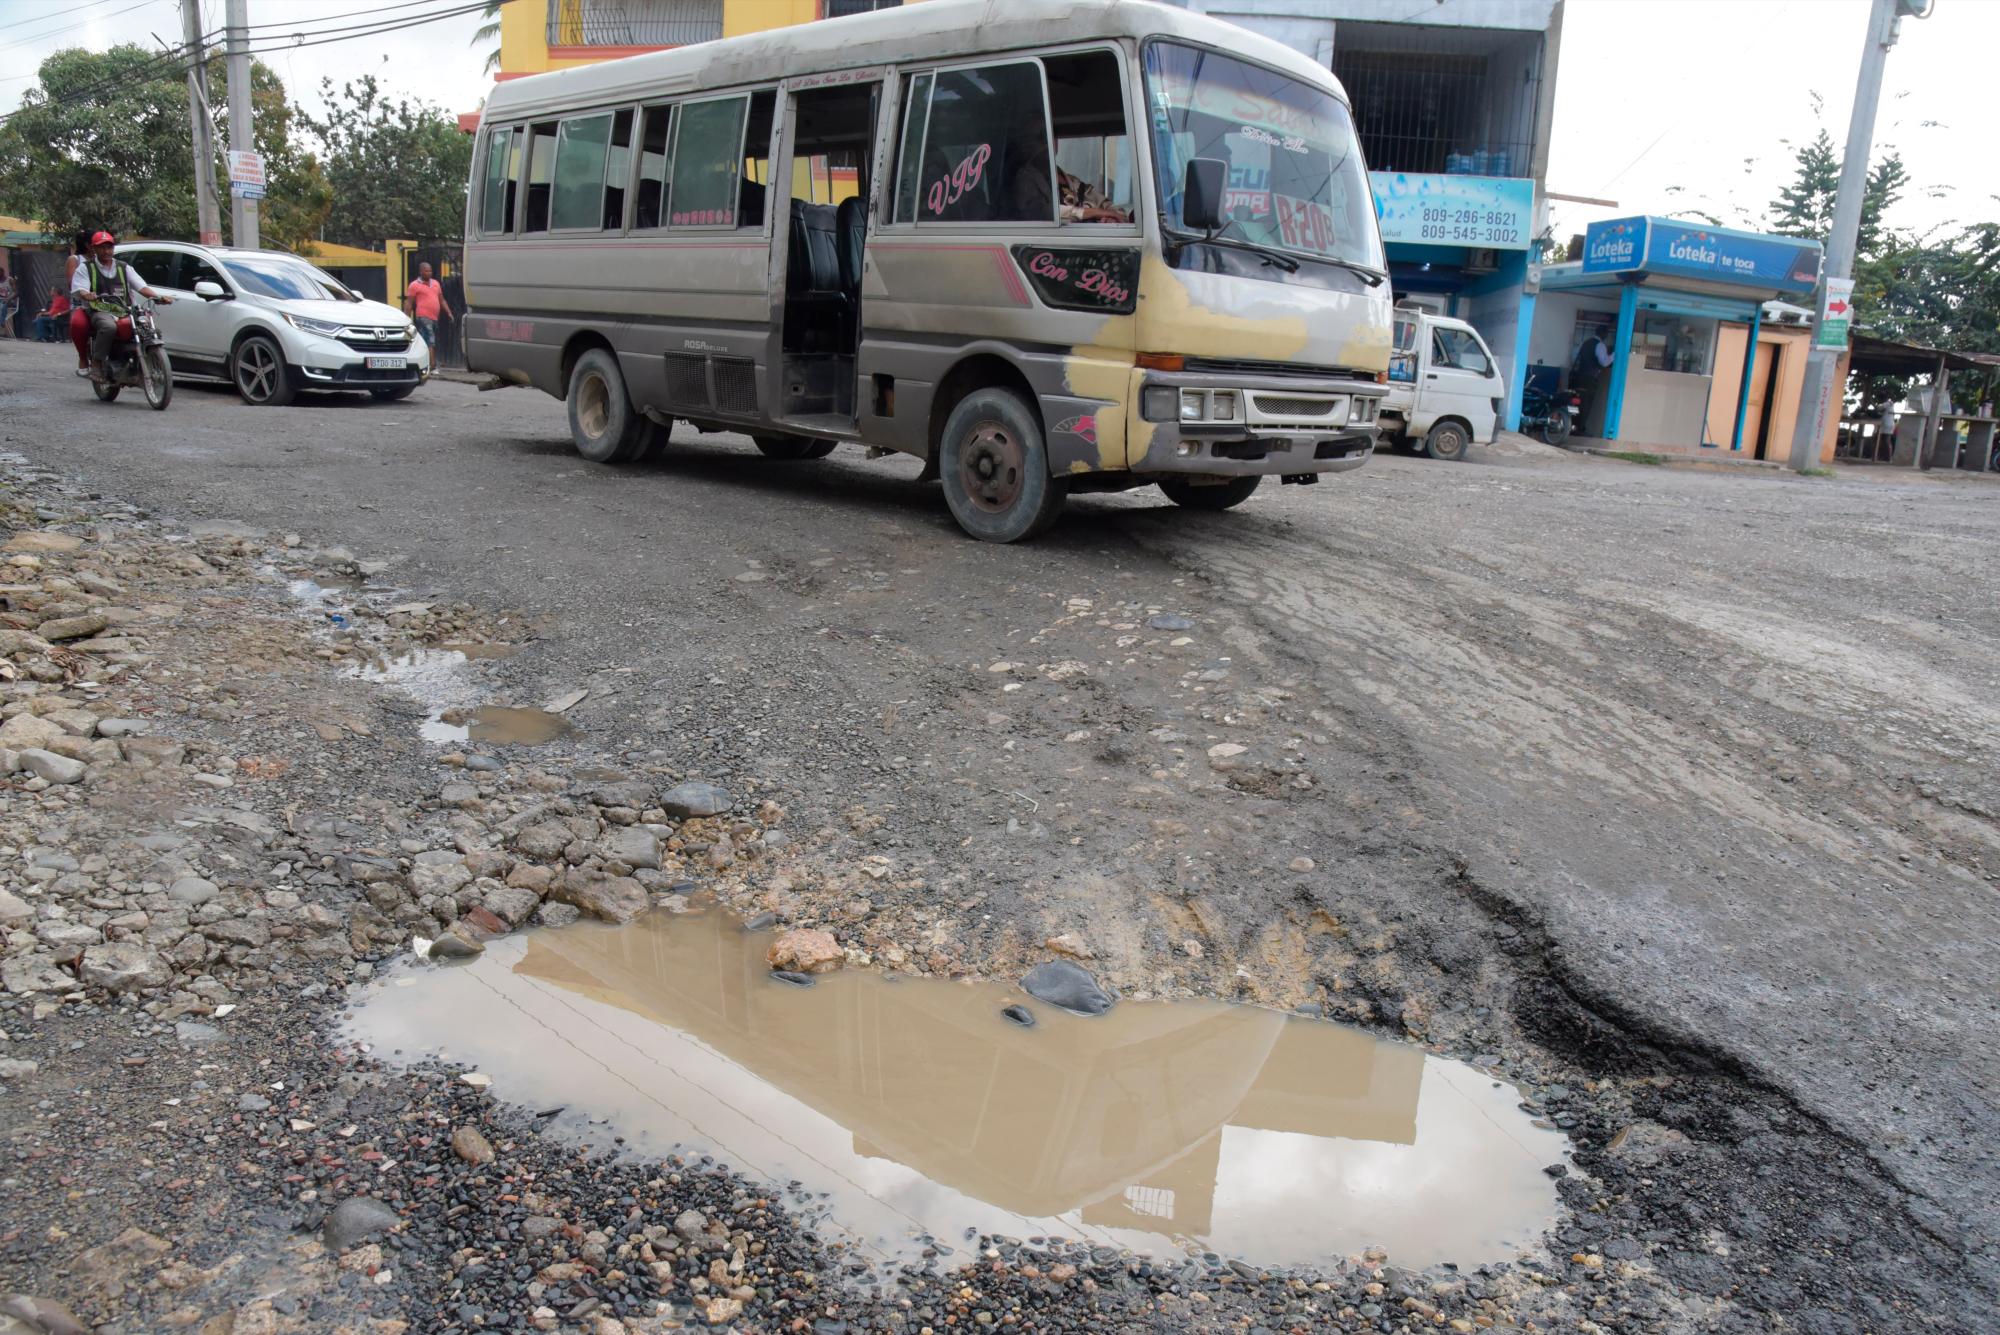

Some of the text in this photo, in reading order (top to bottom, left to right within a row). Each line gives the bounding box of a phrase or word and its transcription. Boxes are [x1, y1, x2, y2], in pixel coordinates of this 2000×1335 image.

[928, 143, 992, 215] VIP
[1423, 208, 1517, 226] 809-296-8621
[1421, 224, 1519, 243] 809-545-3002
[1590, 238, 1634, 258] Loteka
[1669, 242, 1755, 270] Loteka te toca
[1030, 252, 1129, 303] Con Dios
[684, 339, 706, 350] ROSA
